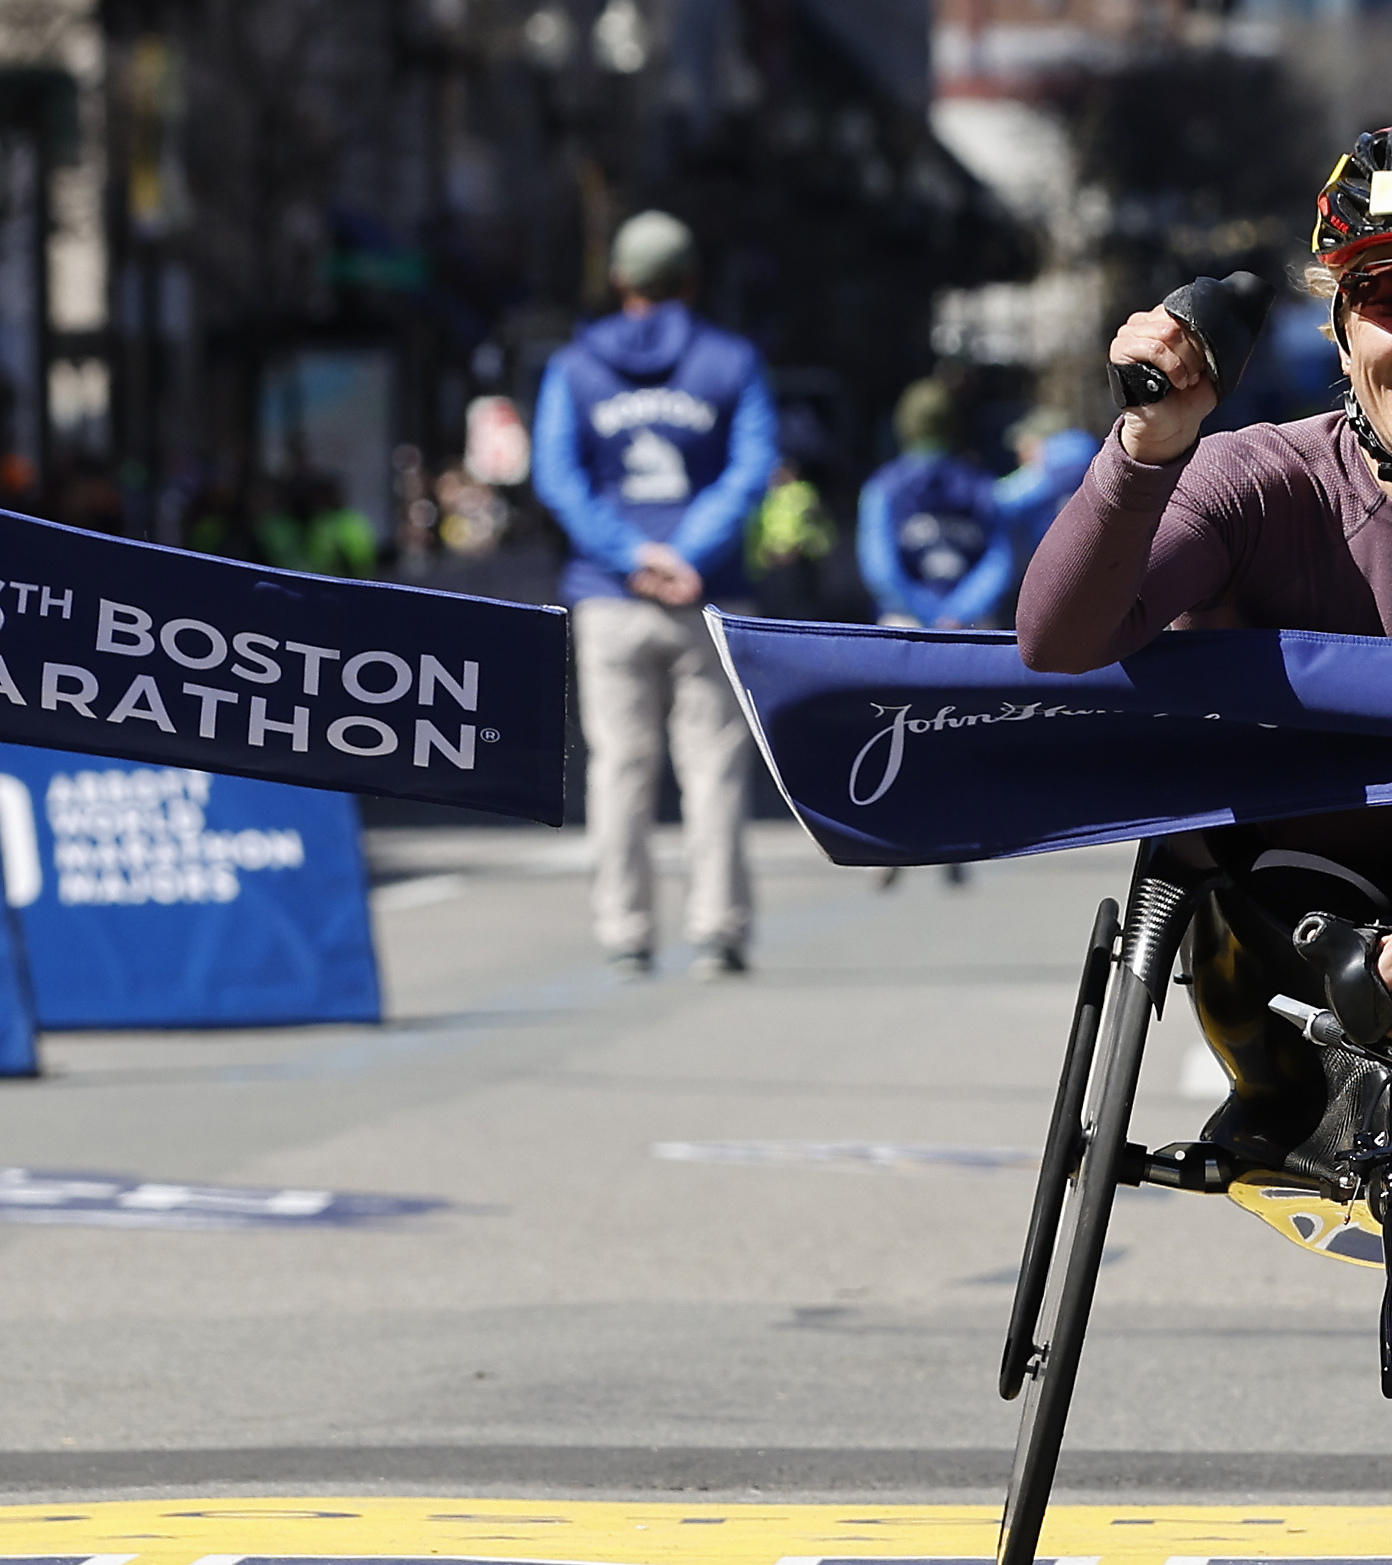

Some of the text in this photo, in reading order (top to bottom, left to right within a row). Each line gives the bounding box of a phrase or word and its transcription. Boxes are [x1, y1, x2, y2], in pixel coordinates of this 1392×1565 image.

[96, 598, 480, 711] BOSTON
[849, 702, 998, 806] John
[55, 829, 304, 871] MARATHON
[58, 863, 240, 905] MAJORS
